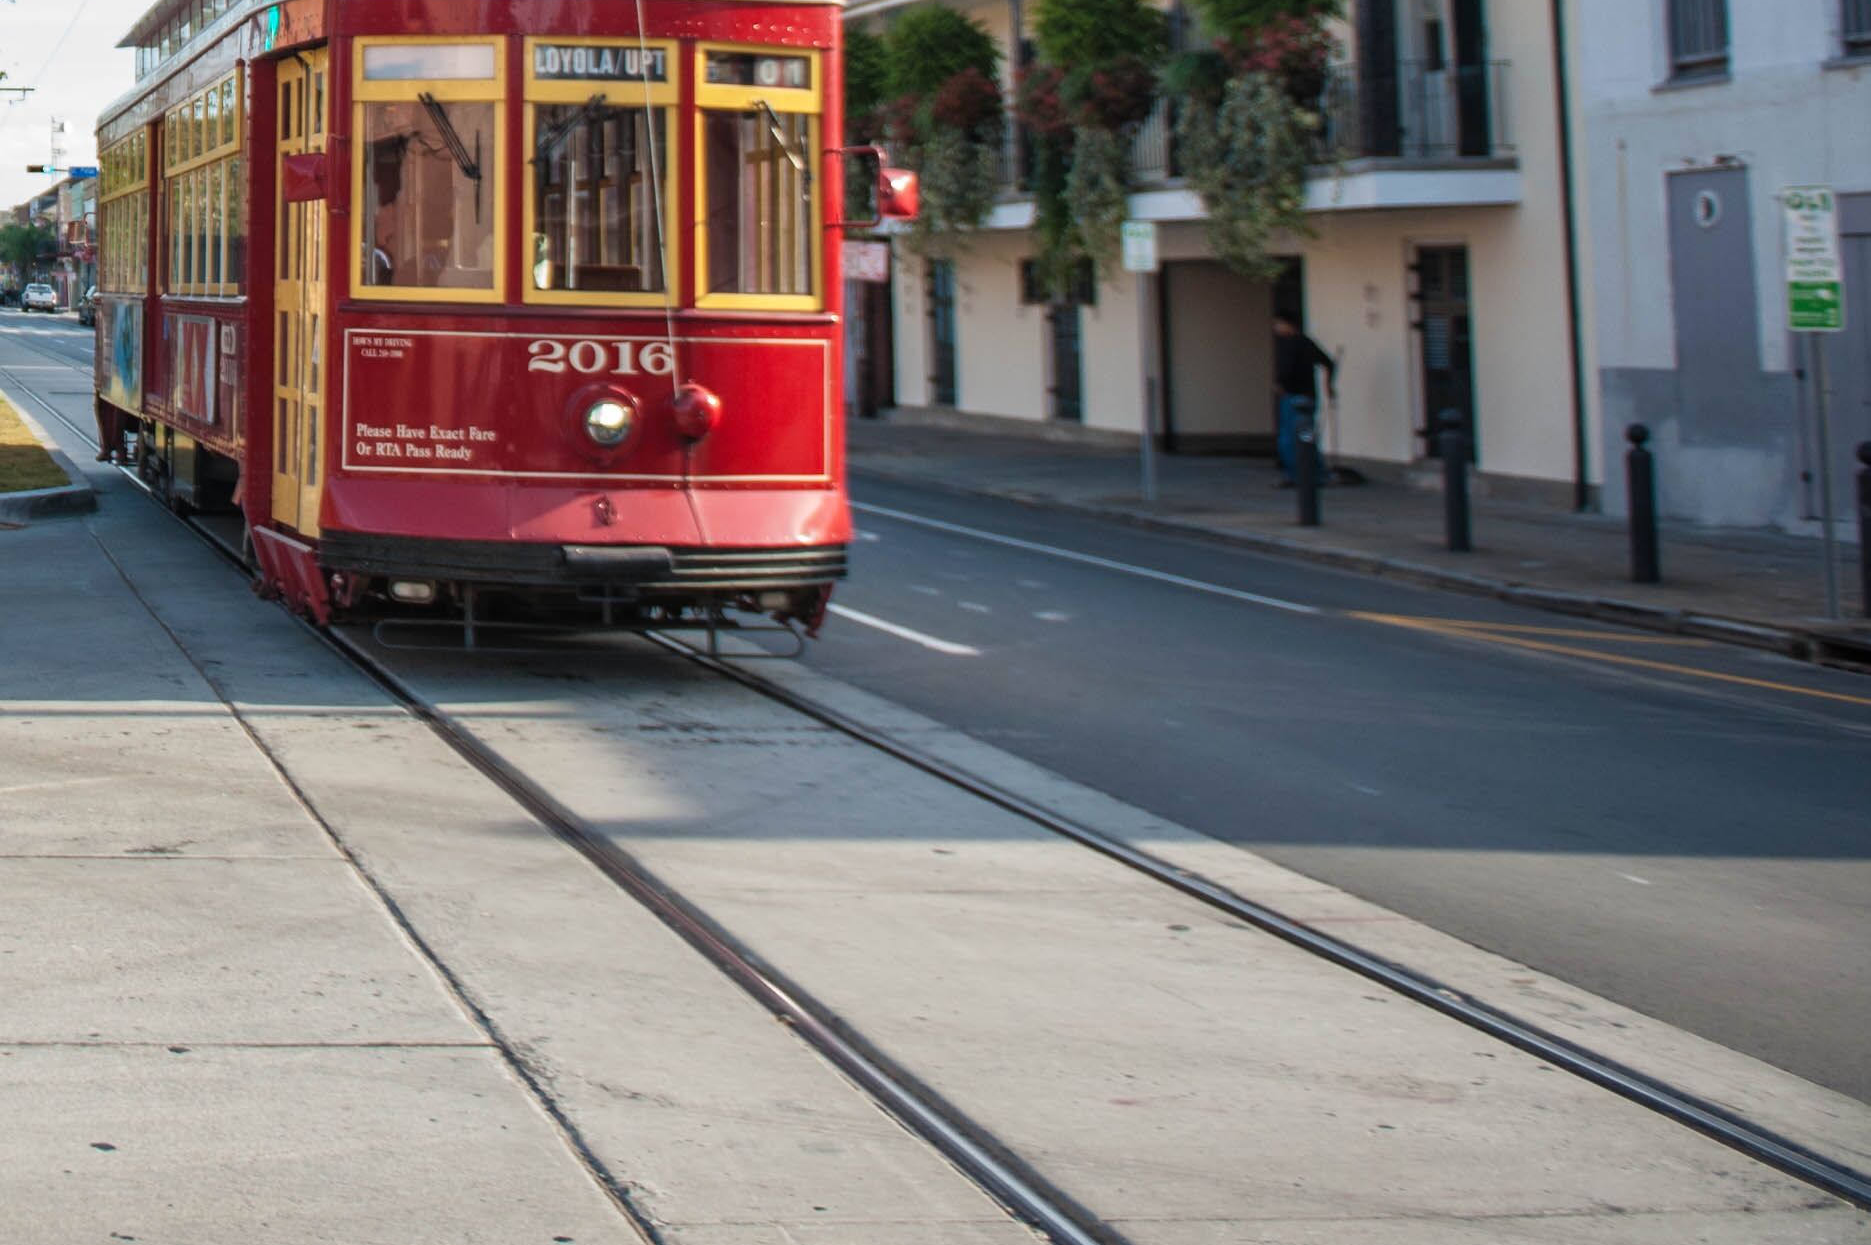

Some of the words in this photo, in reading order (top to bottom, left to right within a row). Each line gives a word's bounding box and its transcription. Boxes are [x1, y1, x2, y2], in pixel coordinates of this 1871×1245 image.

[535, 46, 665, 76] LOYOLA/UPT
[528, 340, 673, 376] 2016
[356, 422, 392, 438] Please
[396, 424, 425, 439] Have
[430, 425, 465, 441] Exact
[469, 426, 497, 441] Fare
[356, 441, 372, 455] Or
[376, 442, 401, 456] RTA
[406, 443, 430, 458] Pass
[435, 444, 473, 460] Ready
